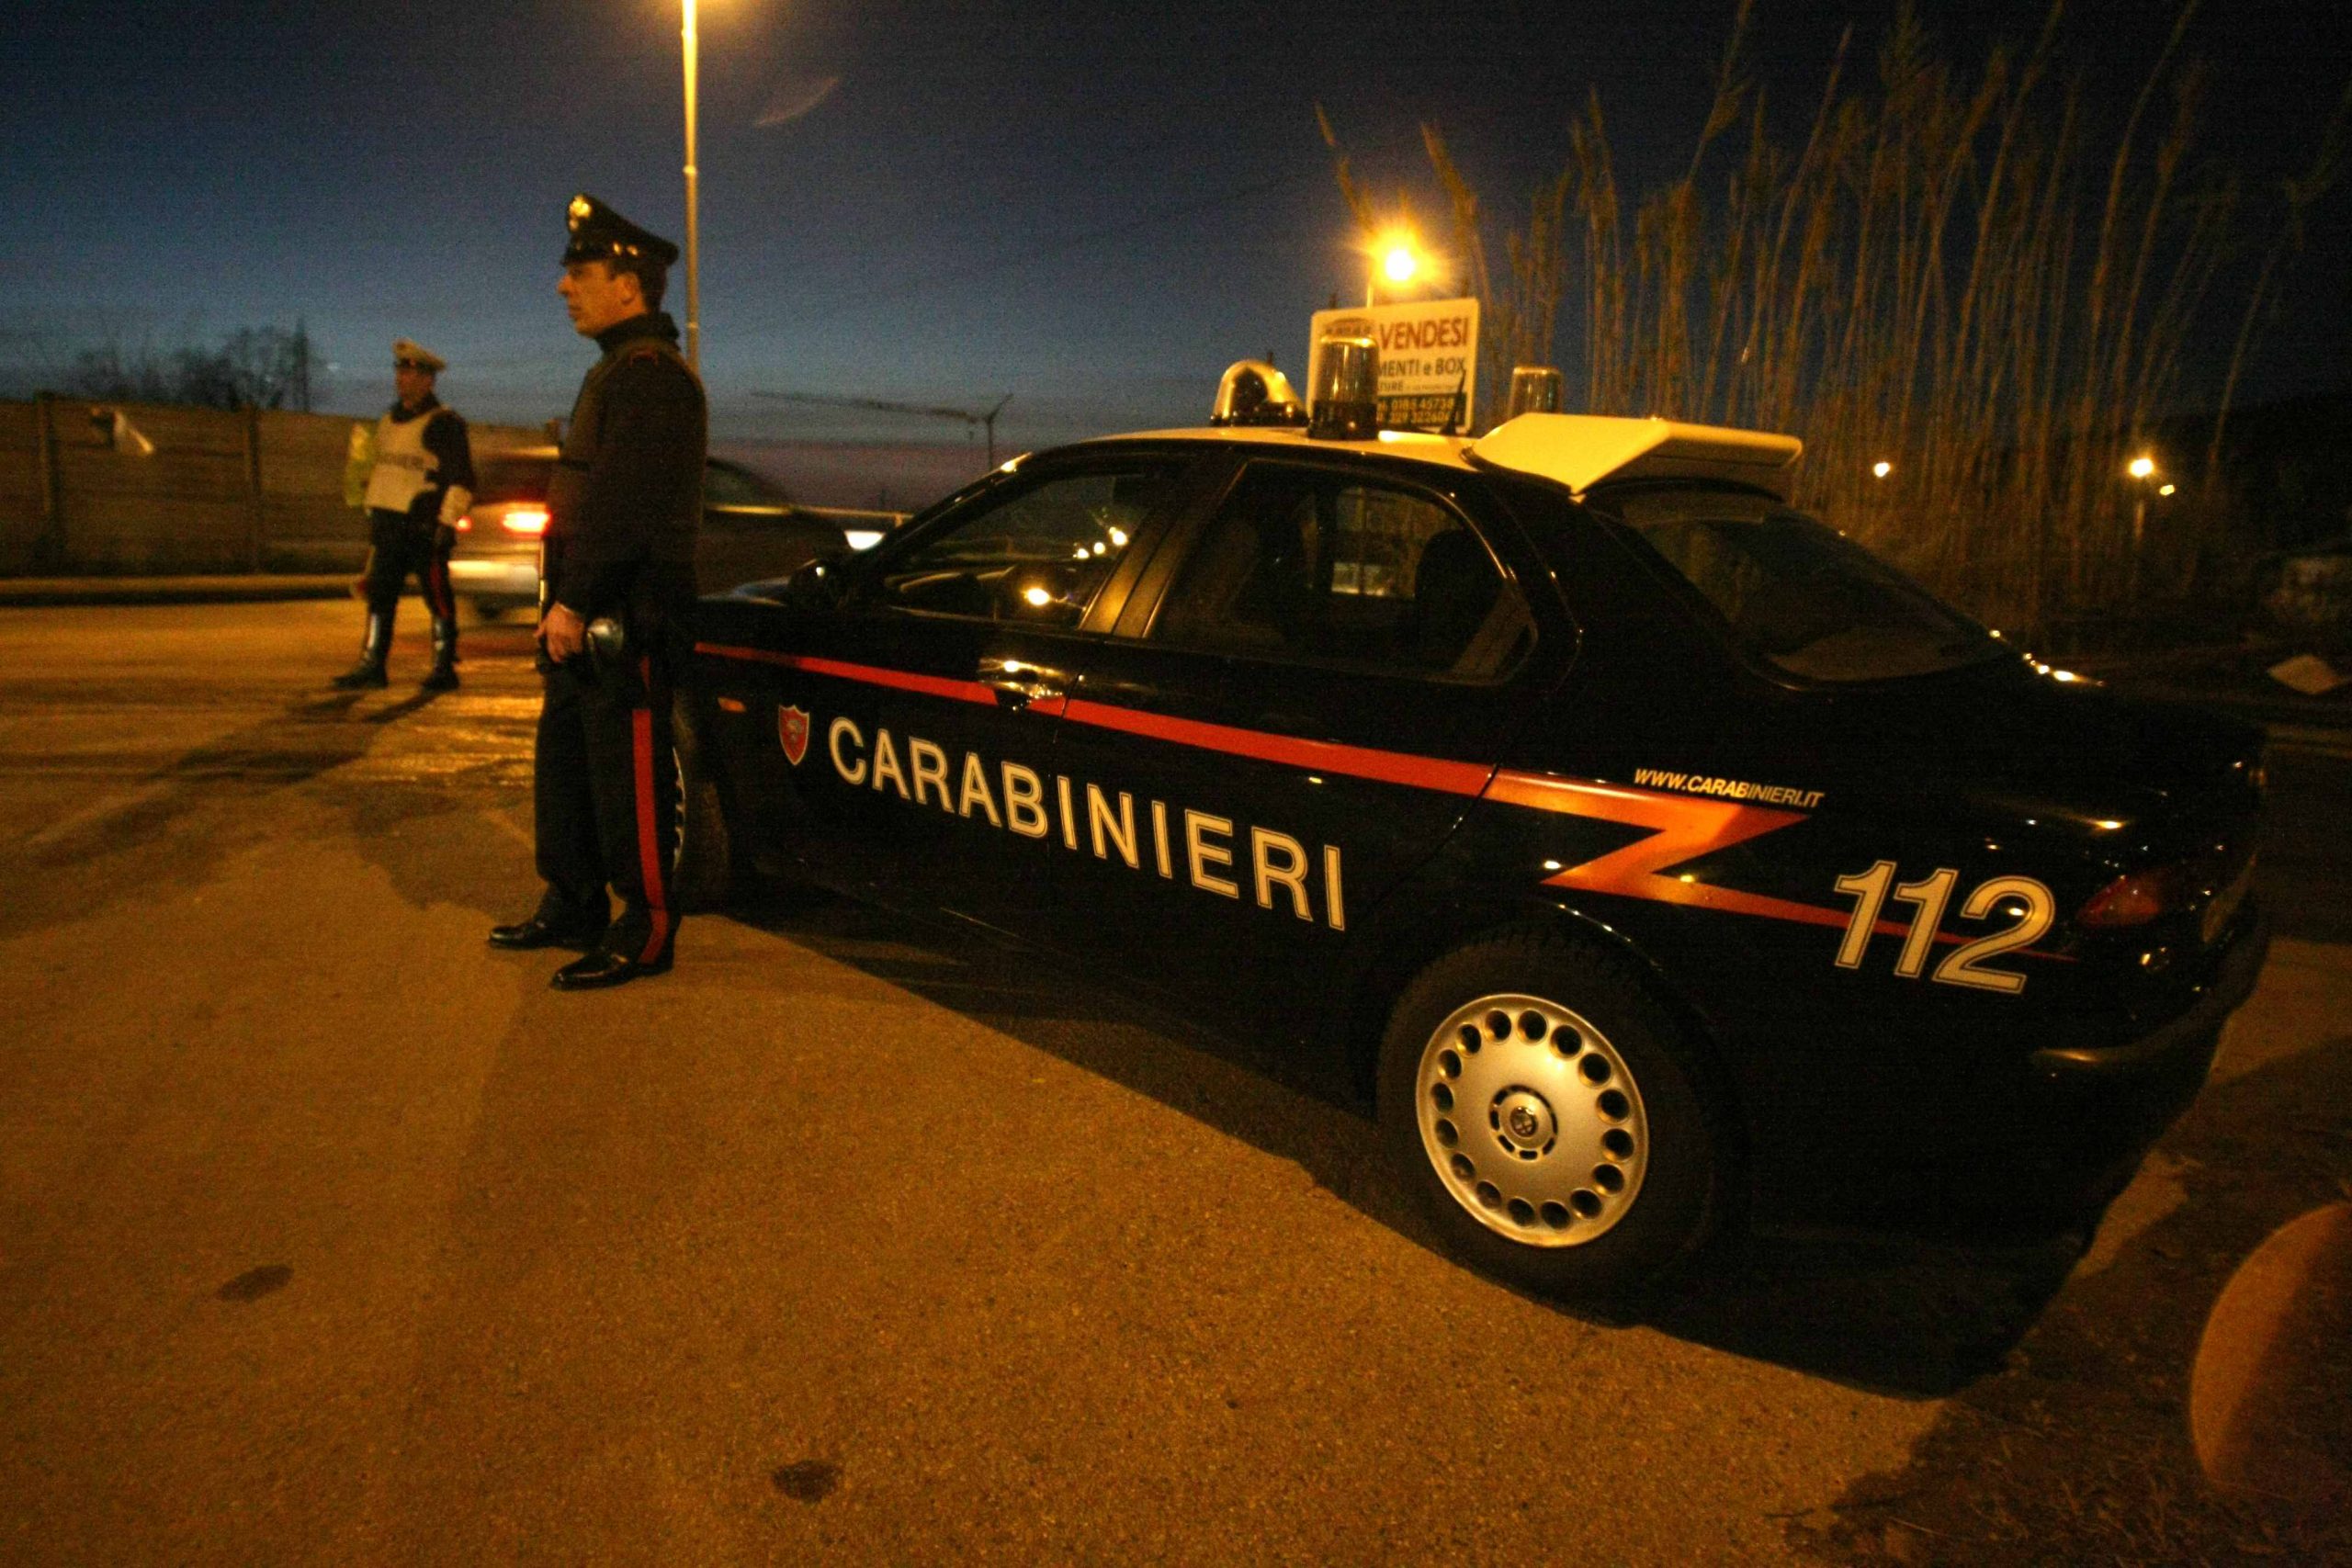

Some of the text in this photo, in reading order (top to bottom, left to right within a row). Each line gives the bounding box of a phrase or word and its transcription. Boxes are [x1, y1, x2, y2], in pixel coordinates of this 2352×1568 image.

[1379, 318, 1468, 350] VENDESI
[1378, 356, 1466, 377] MENTI e BOX
[1634, 768, 1825, 809] WWW.CARABINIERI.IT
[829, 716, 1345, 931] CARABINIERI
[1834, 859, 2056, 995] 112
